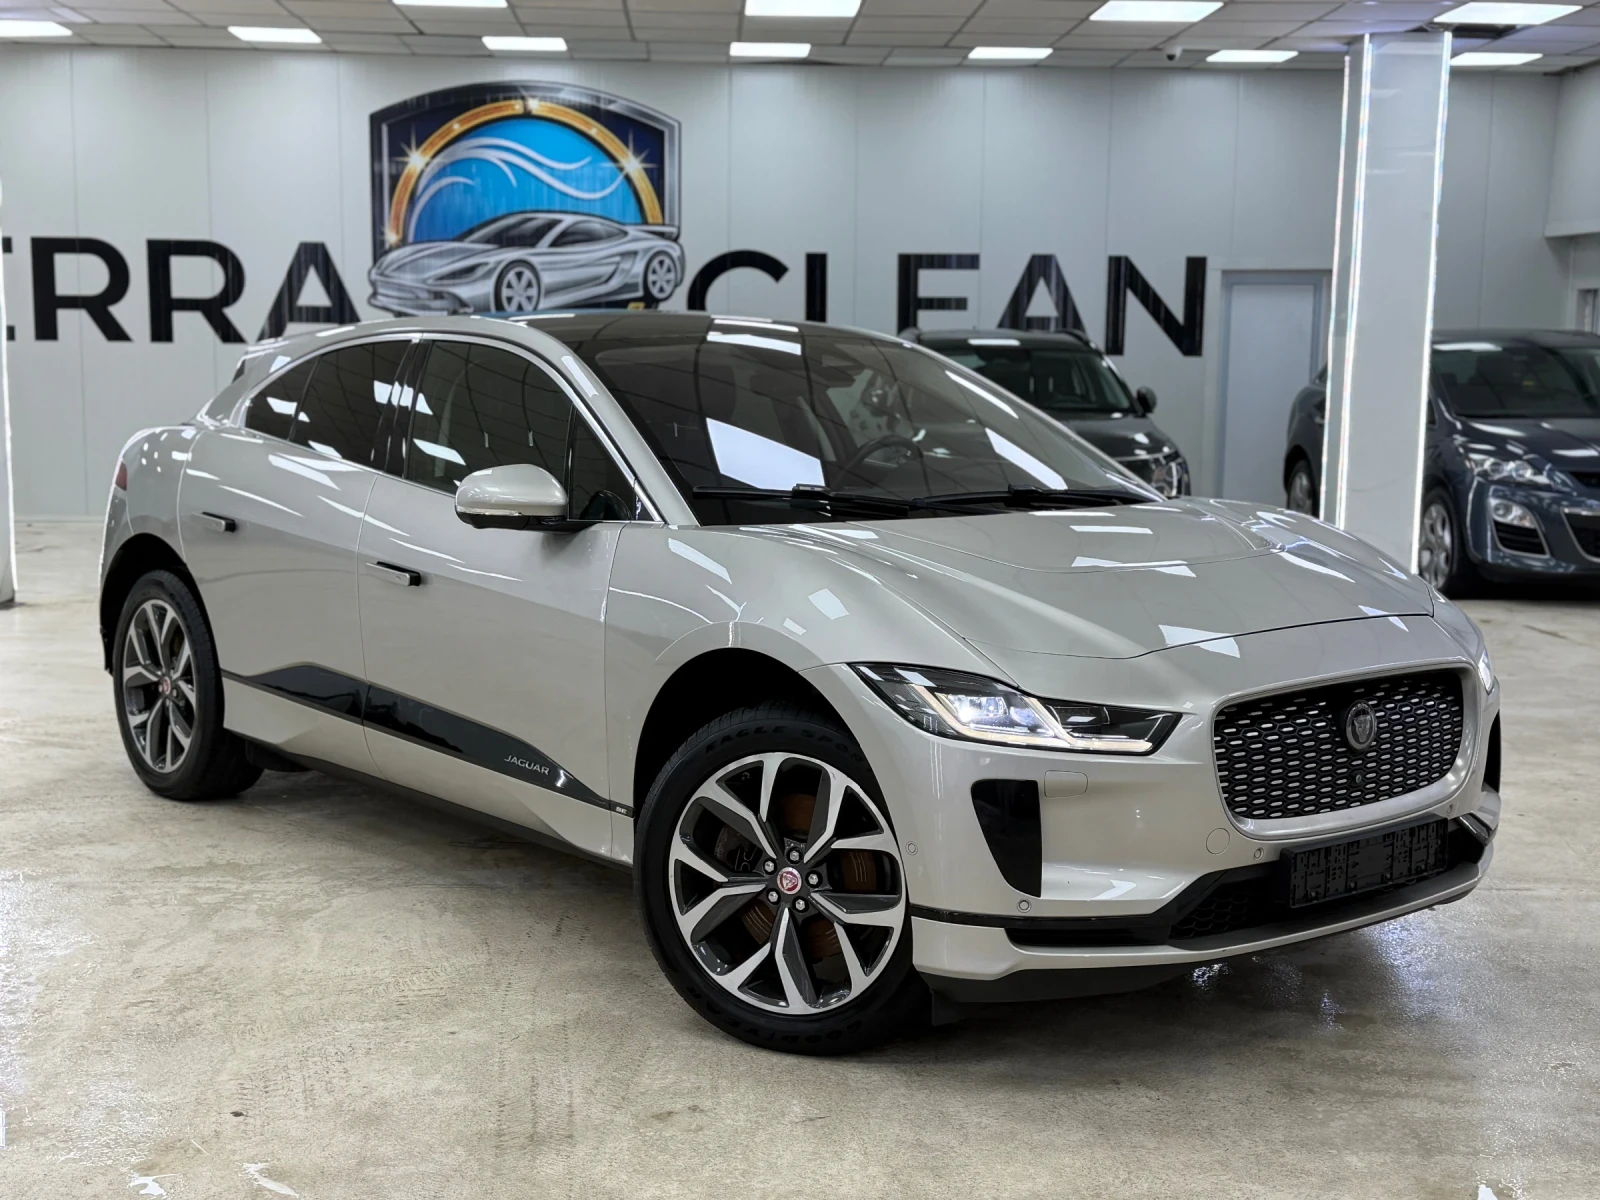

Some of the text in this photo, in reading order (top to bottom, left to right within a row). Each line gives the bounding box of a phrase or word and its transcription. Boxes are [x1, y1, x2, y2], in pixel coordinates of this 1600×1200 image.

[504, 755, 550, 776] JAGUAR
[705, 725, 871, 773] EAGLE SPOR
